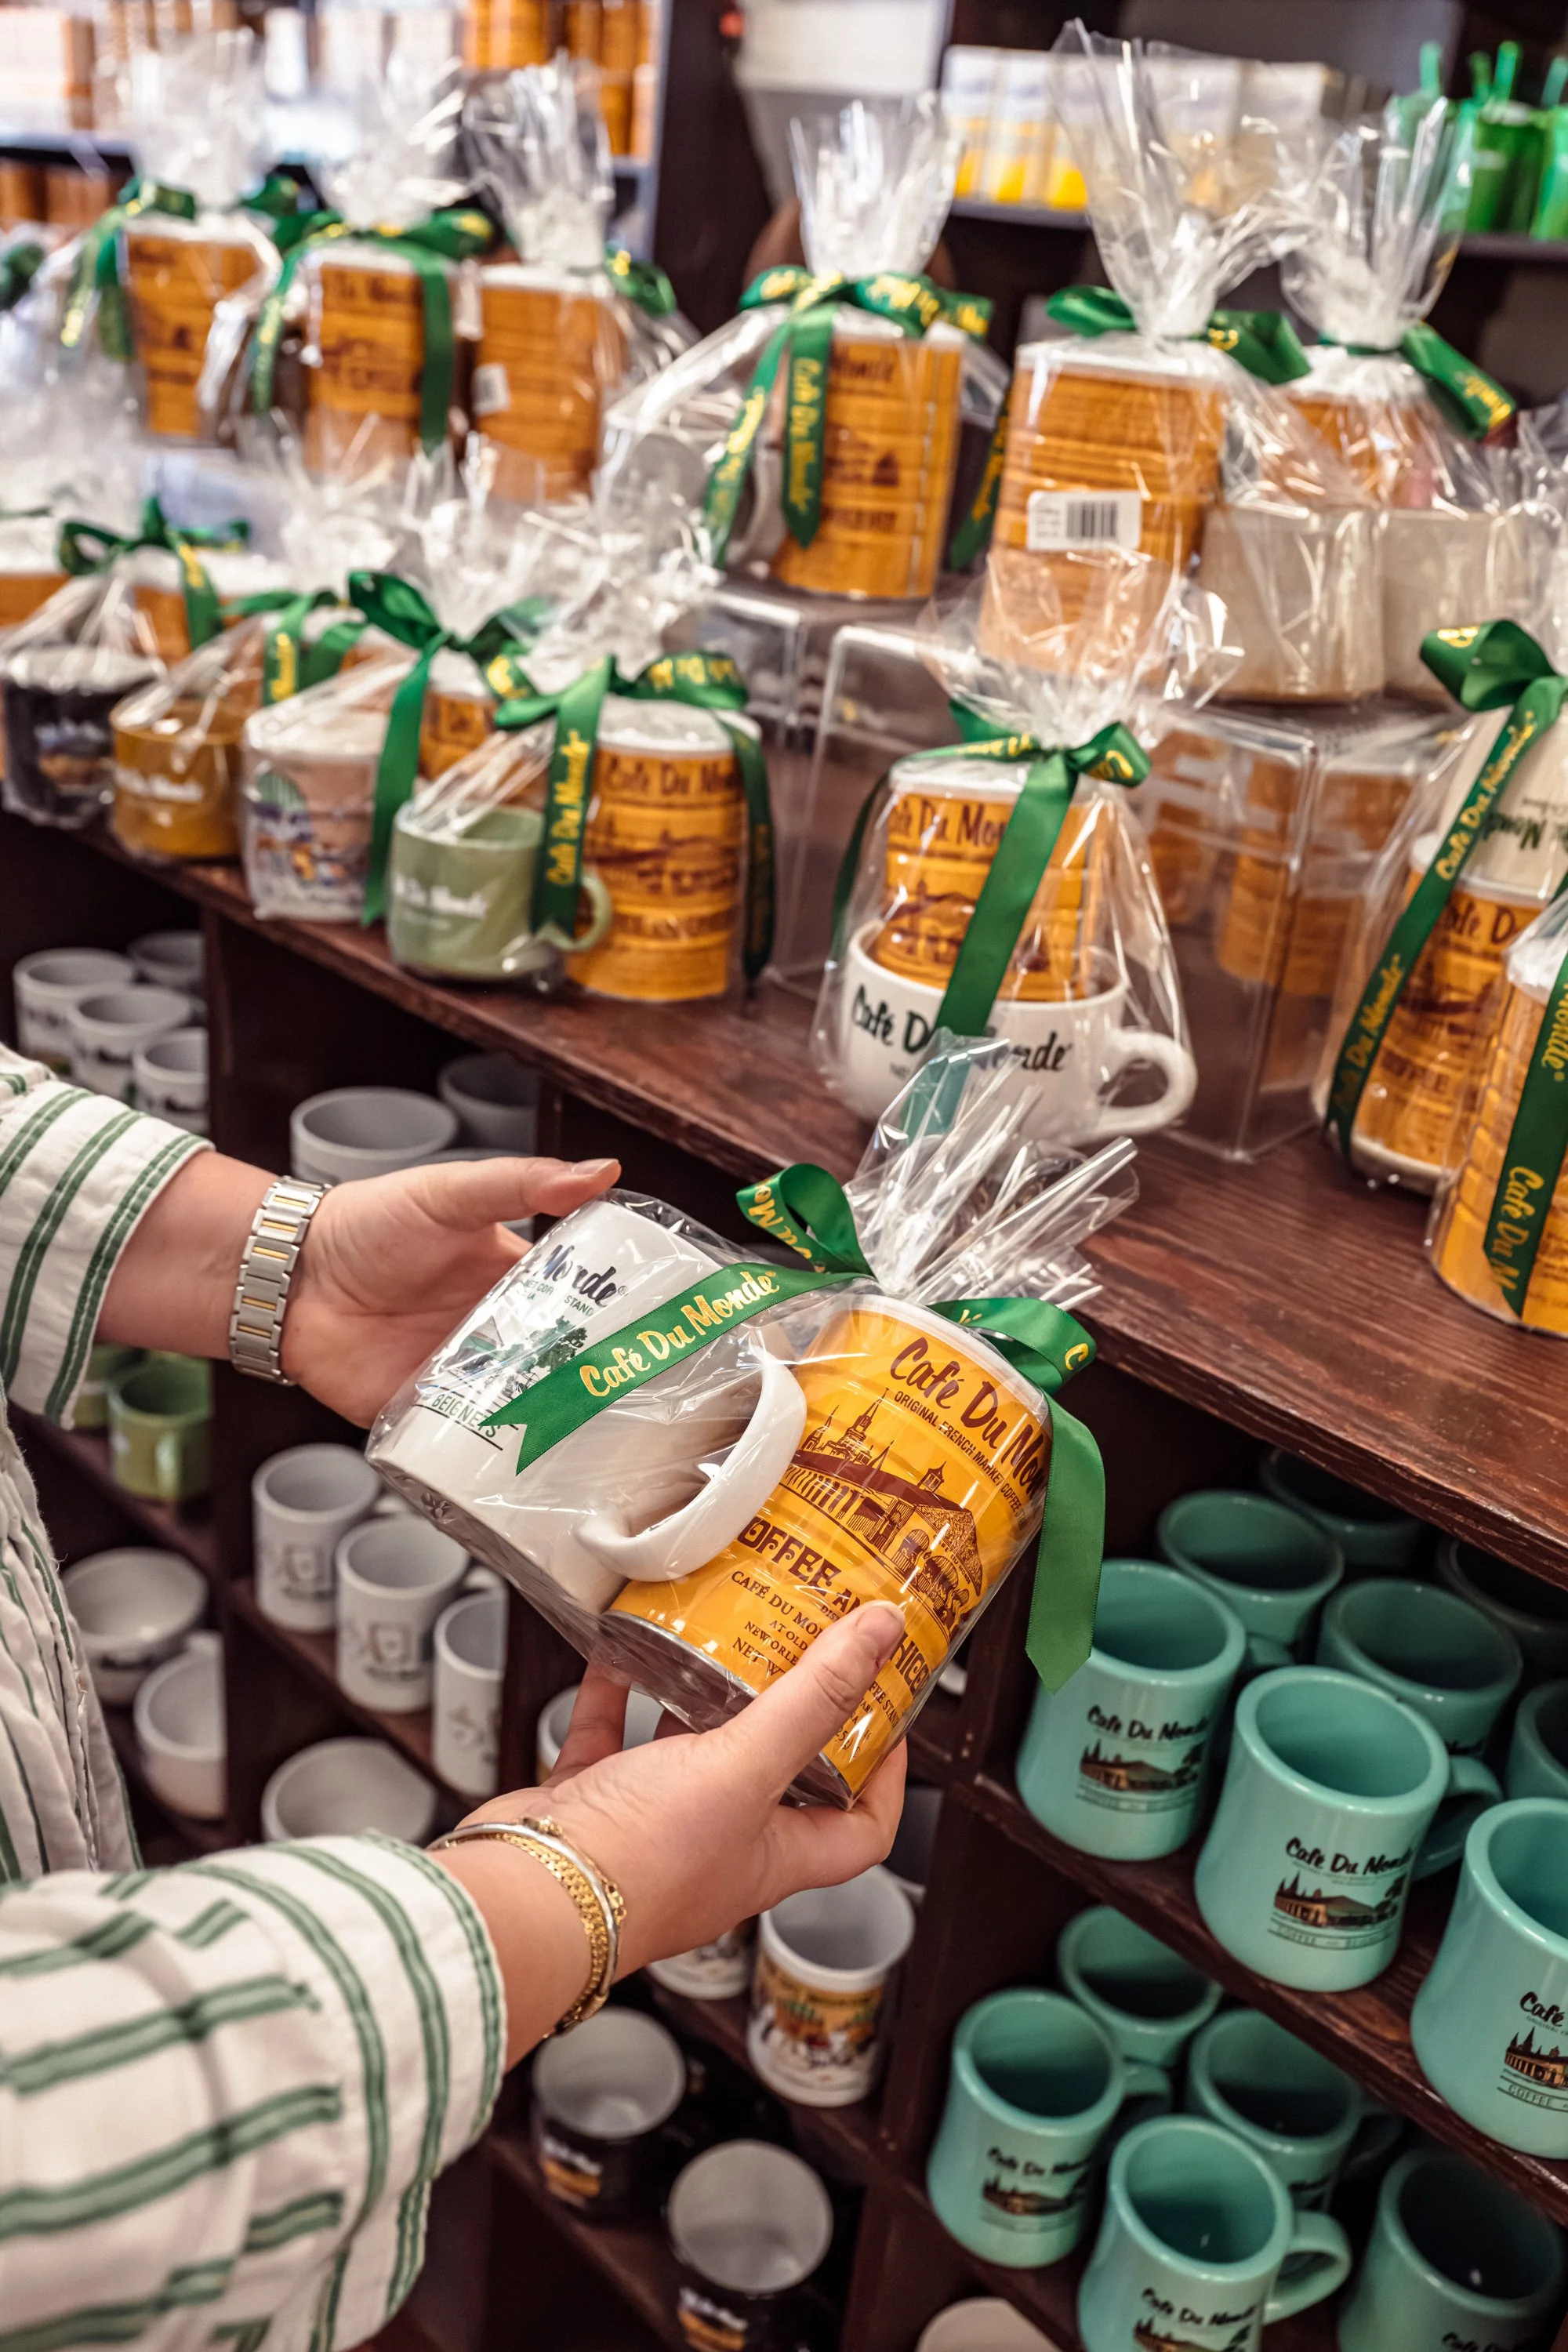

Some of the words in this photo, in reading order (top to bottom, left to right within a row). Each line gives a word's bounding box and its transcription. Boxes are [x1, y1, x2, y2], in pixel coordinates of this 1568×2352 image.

[564, 1294, 594, 1317] STAND
[579, 1348, 652, 1397] Café
[637, 1325, 695, 1360] Du
[681, 1270, 780, 1336] Monde
[890, 1336, 965, 1410] Café
[960, 1380, 1007, 1450] Du
[894, 1390, 940, 1428] ORIGINAL
[938, 1421, 977, 1456] FRENCH
[972, 1450, 1005, 1486] MARKET
[1000, 1483, 1023, 1514] COFFEE
[738, 1516, 842, 1598] OFFEE
[731, 1570, 771, 1599] CAFÉ
[768, 1593, 793, 1616] DU
[882, 1700, 900, 1729] STAND
[732, 1636, 768, 1664] NET
[745, 1621, 771, 1645] NEW
[770, 1639, 799, 1666] ORLE
[768, 1619, 786, 1634] AT
[786, 1630, 808, 1652] OLD
[1330, 1852, 1359, 1875] Du
[1519, 1991, 1566, 2027] Café
